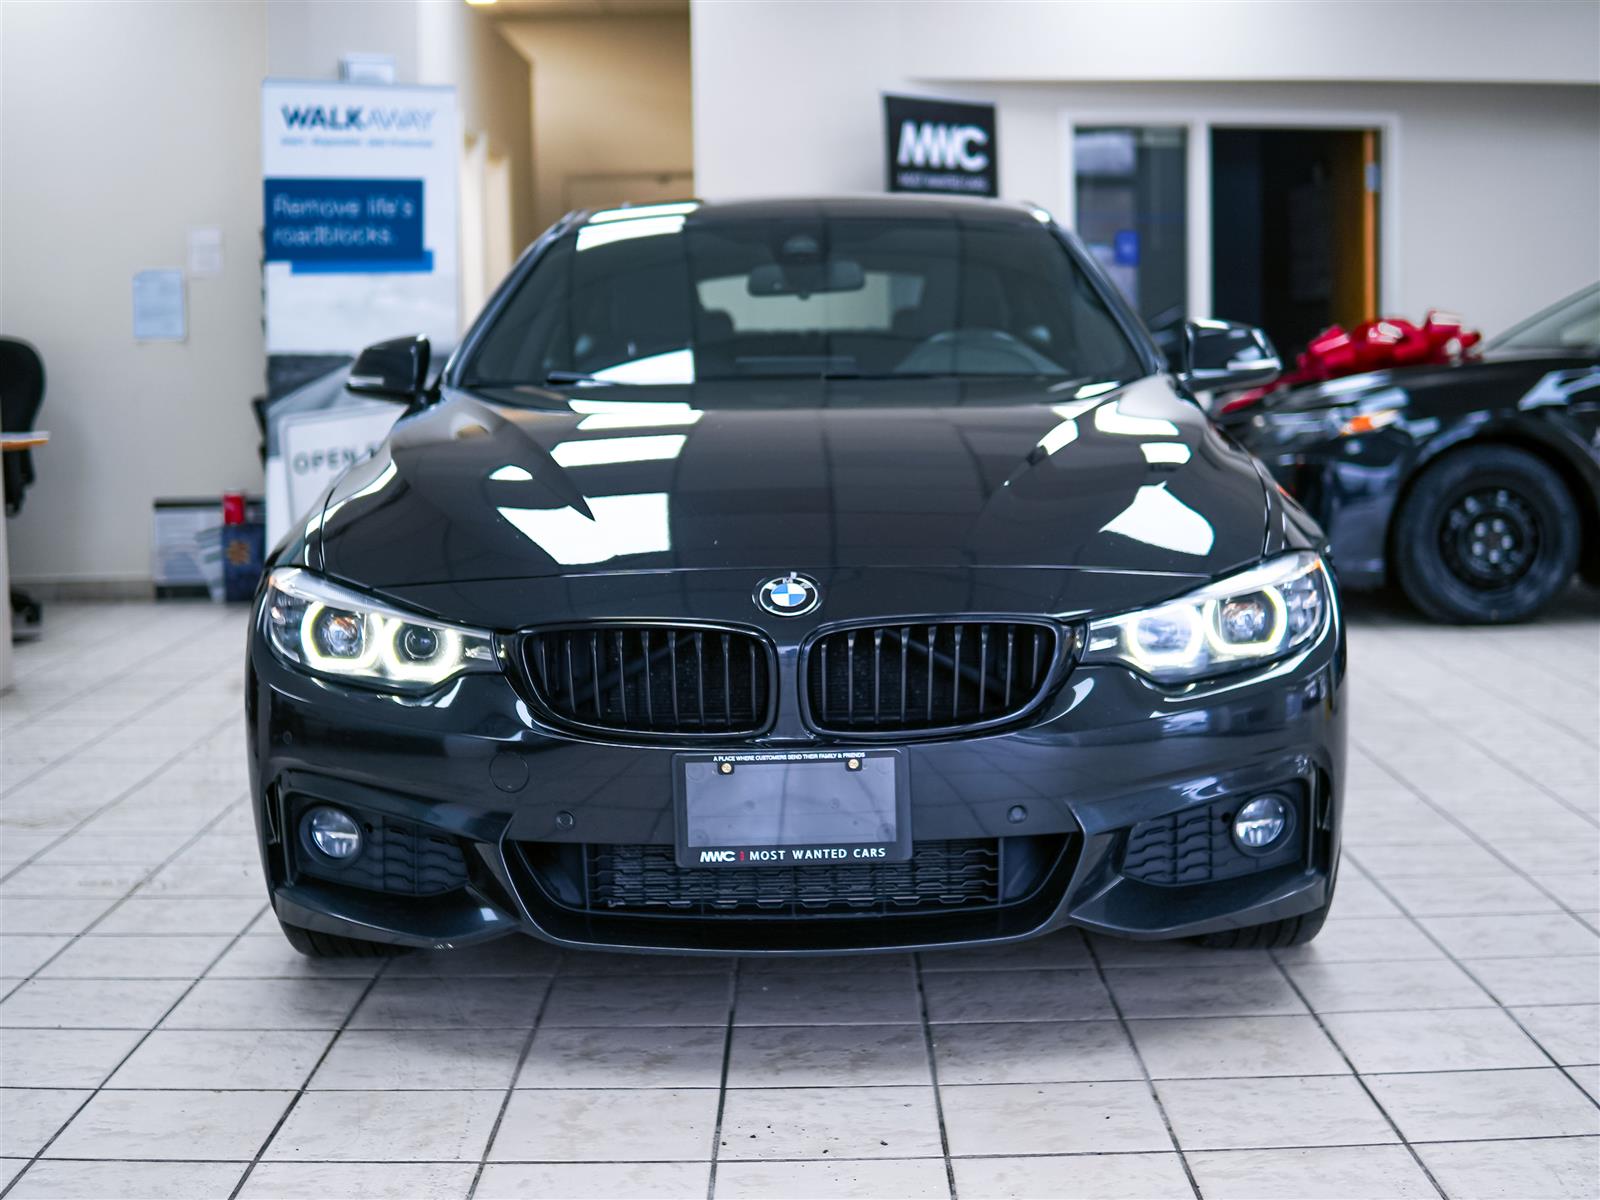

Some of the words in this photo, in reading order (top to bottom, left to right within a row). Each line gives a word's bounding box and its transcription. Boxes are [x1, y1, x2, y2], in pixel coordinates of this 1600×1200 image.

[272, 194, 360, 217] Remove
[367, 196, 414, 217] life's
[293, 448, 358, 475] OPEN
[699, 850, 736, 863] MWC
[749, 850, 786, 861] MOST
[791, 848, 848, 860] WANTED
[853, 847, 886, 858] CARS
